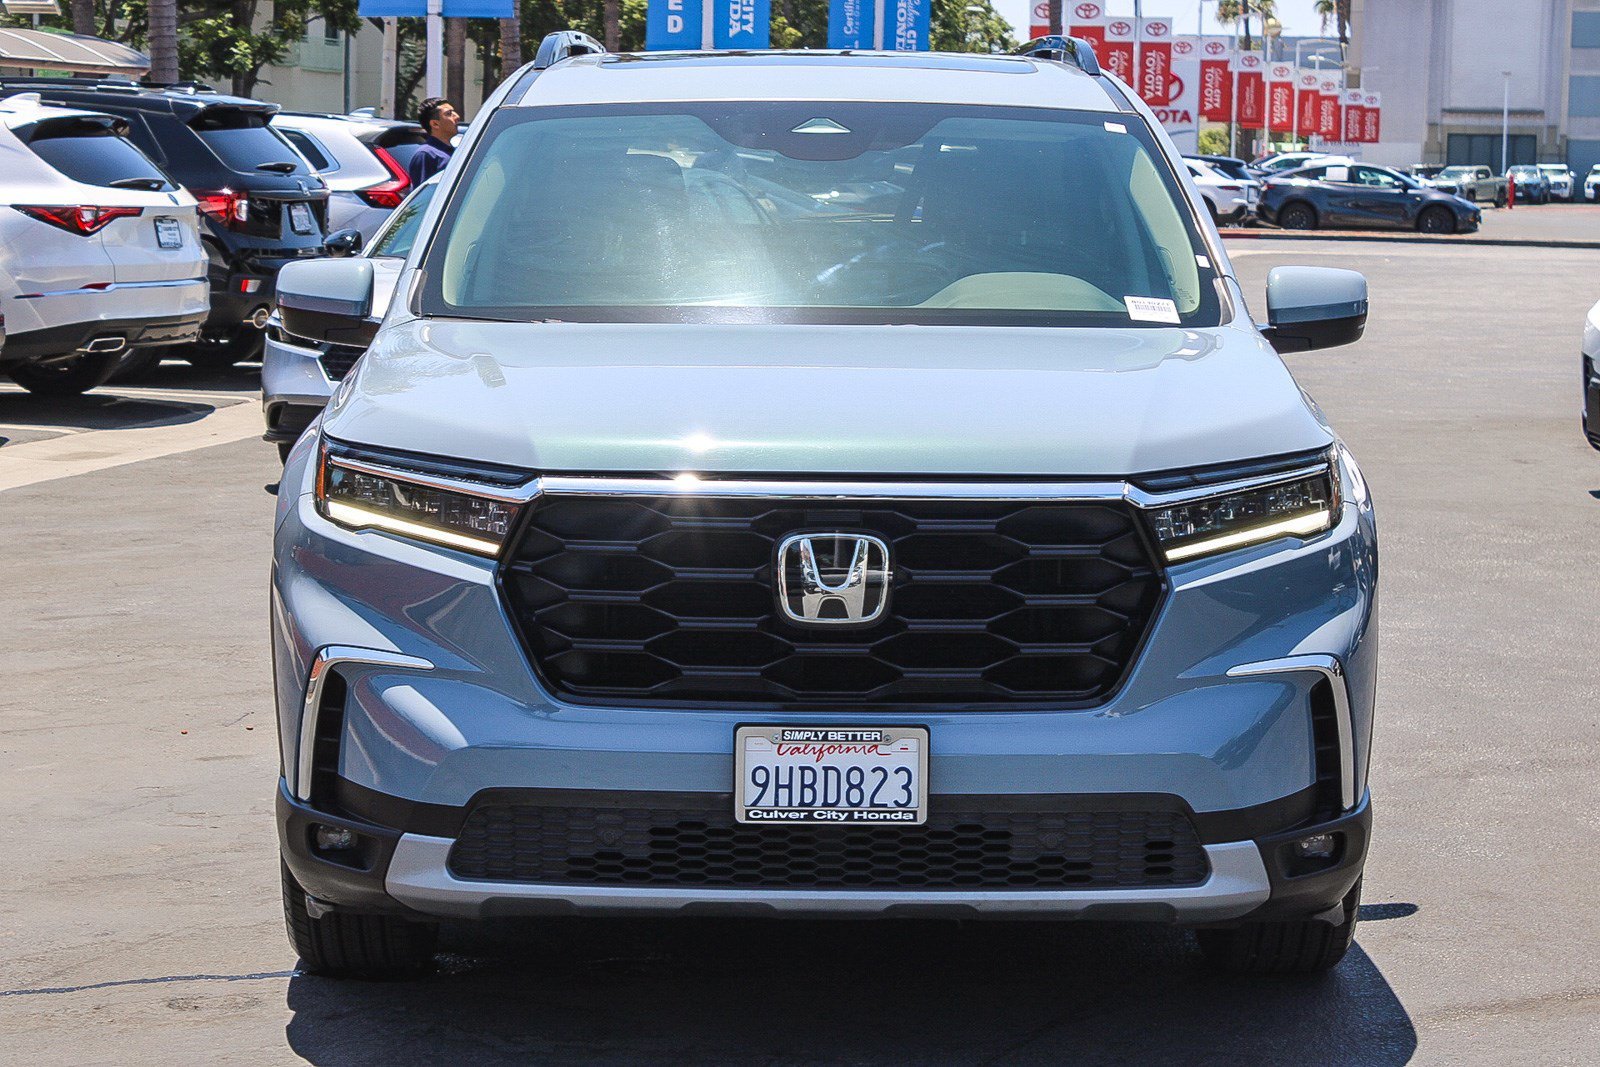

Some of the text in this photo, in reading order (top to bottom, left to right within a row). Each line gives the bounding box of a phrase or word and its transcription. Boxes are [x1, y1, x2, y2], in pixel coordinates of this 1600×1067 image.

[1144, 49, 1156, 100] TOYOTA
[1154, 74, 1164, 98] CITY
[1203, 66, 1214, 111] TOYOTA
[1212, 88, 1222, 109] CITY
[1273, 87, 1281, 125] TOYOTA
[1154, 109, 1192, 123] OTA
[783, 731, 881, 742] SIMPLY BETTER
[776, 742, 892, 763] California
[750, 765, 913, 808] 9HBD823
[748, 810, 914, 821] Culver City Honda
